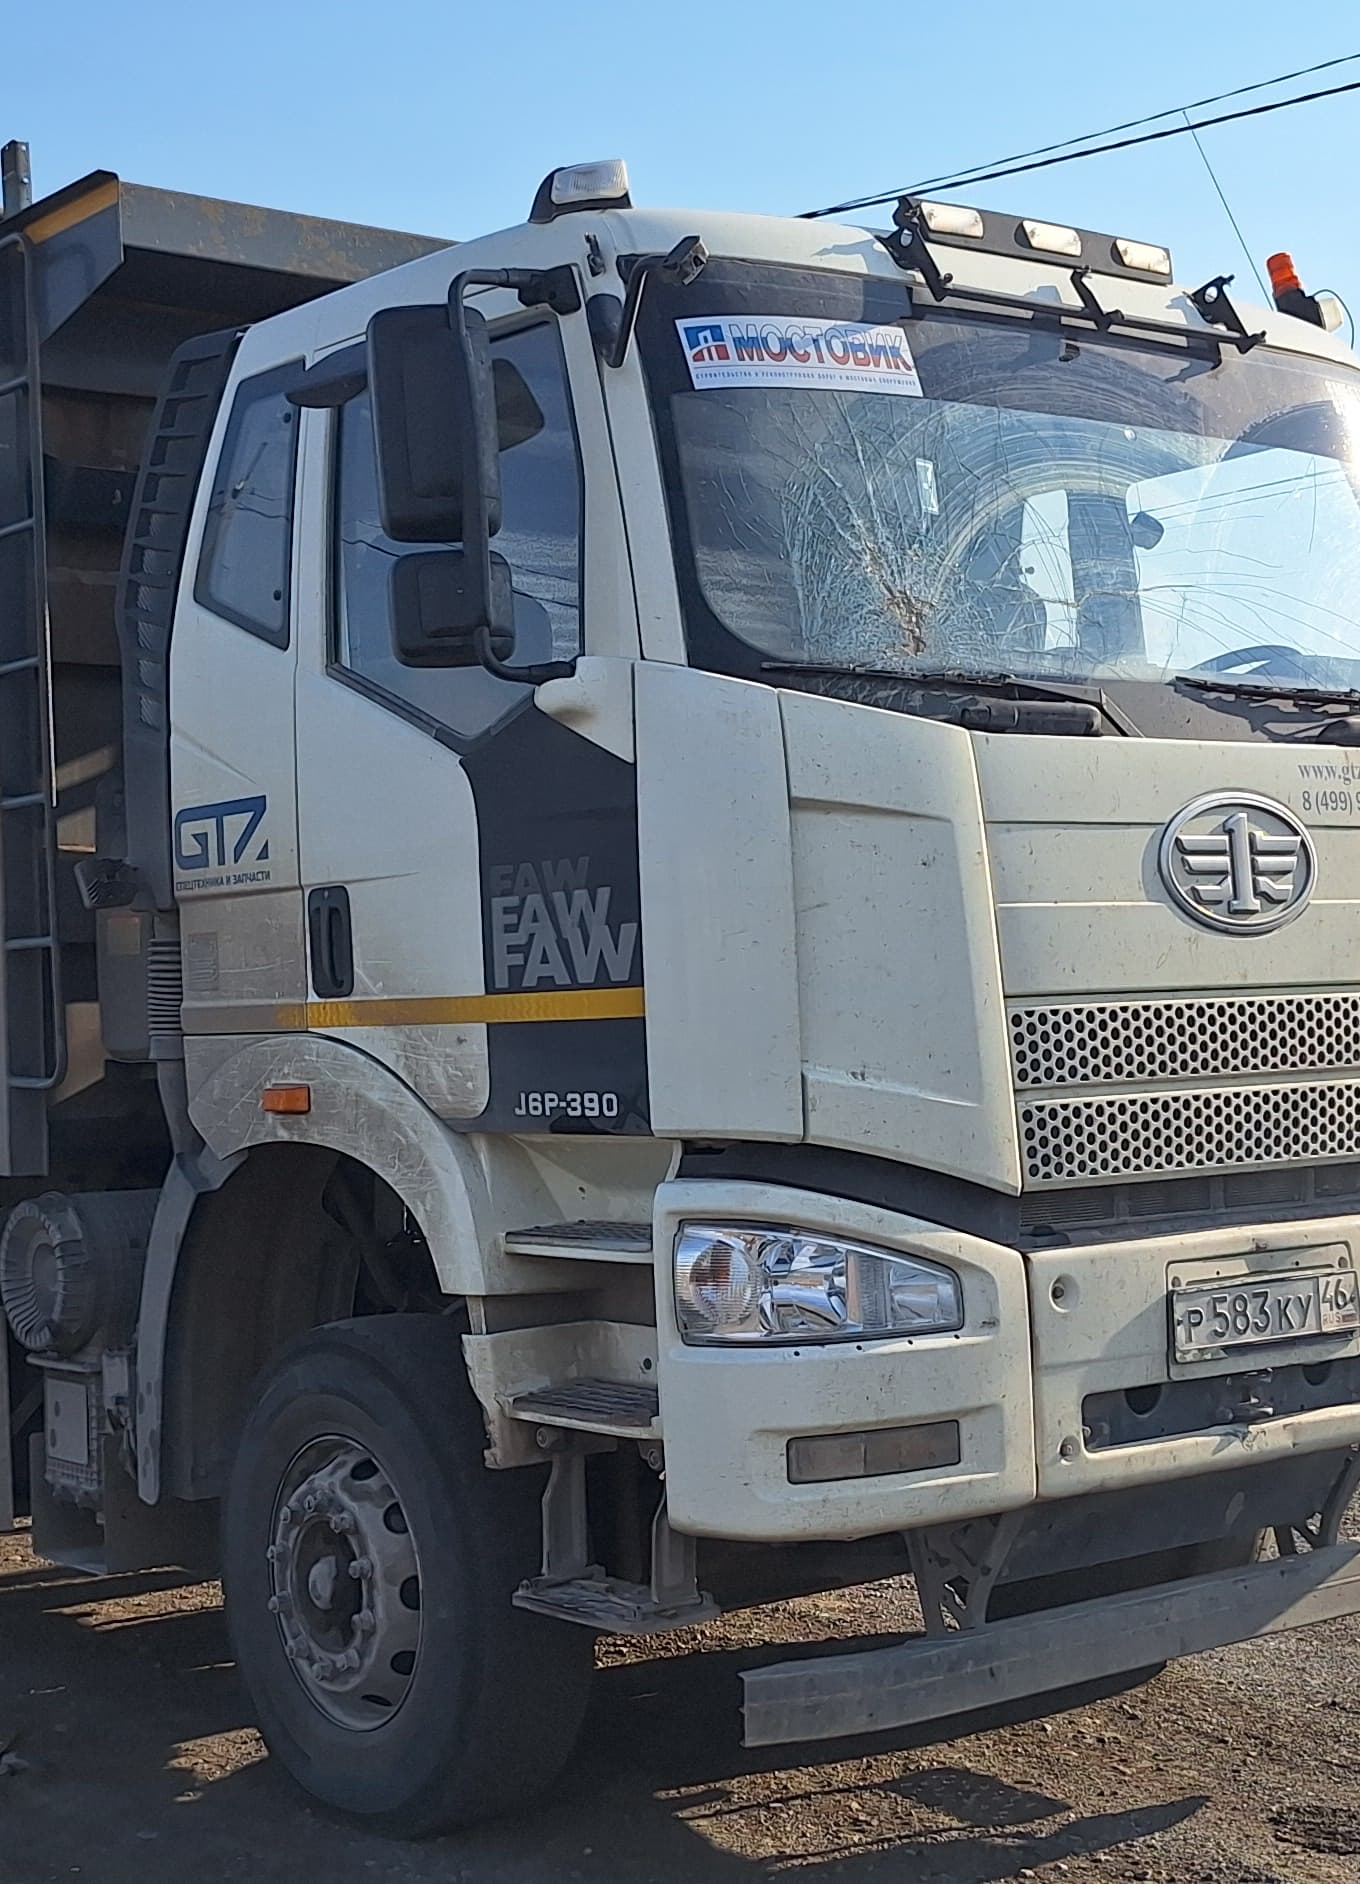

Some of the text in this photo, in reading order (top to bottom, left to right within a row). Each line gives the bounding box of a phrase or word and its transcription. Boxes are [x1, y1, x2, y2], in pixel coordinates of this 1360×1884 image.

[728, 323, 913, 372] МОСТОВИК
[1302, 790, 1312, 811] 8
[1315, 790, 1353, 815] (499)
[174, 795, 270, 870] GTZ
[490, 856, 590, 897] FAW
[490, 887, 612, 940] FAW
[493, 922, 638, 990] FAW
[514, 1091, 618, 1117] J6P-390
[1321, 1278, 1348, 1312] 46
[1322, 1311, 1342, 1325] RUS
